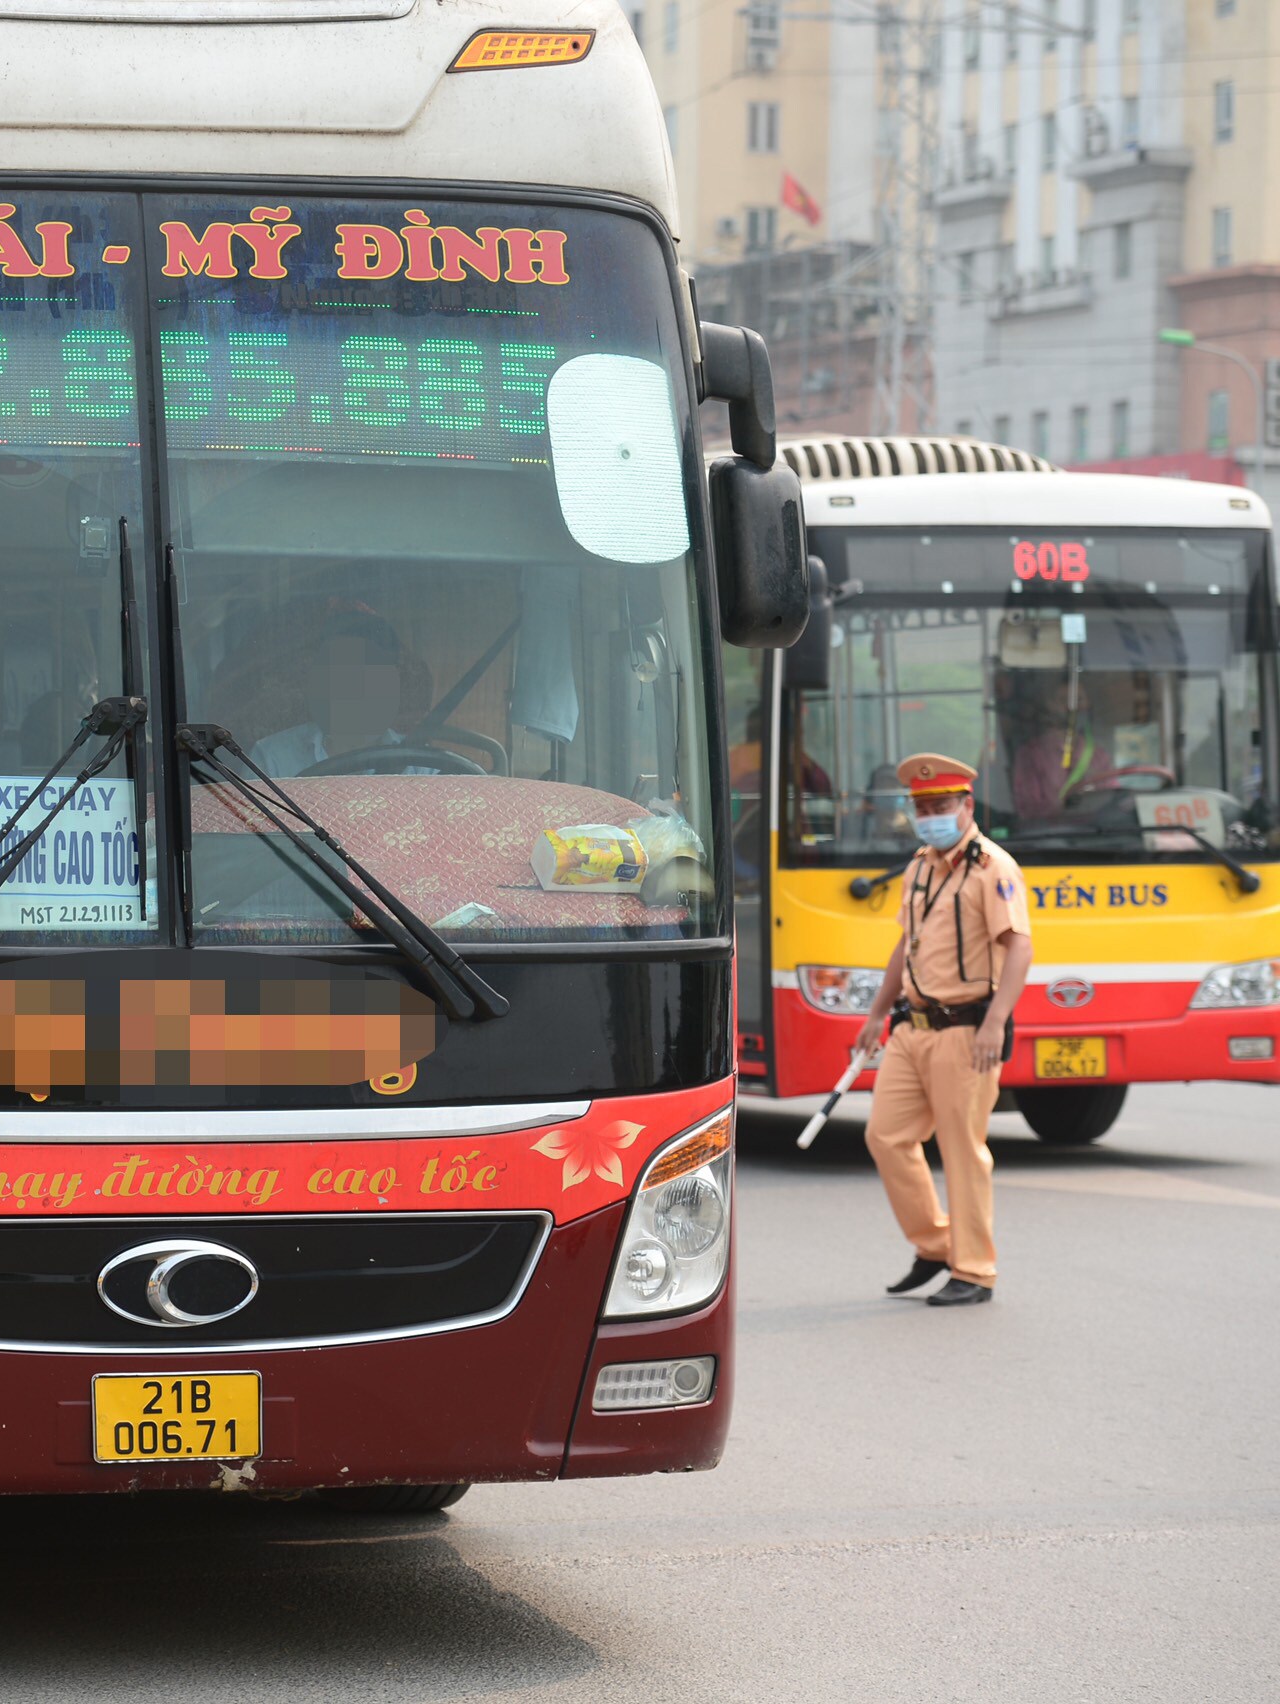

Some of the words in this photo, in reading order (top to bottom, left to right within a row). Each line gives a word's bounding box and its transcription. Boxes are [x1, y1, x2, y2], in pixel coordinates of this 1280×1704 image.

[159, 206, 302, 280] MỸ
[334, 209, 571, 285] ĐÌNH
[1013, 541, 1090, 582] 60B
[53, 829, 95, 886] CAO
[100, 817, 140, 887] TỐC
[1031, 874, 1096, 909] YẾN
[1107, 883, 1168, 907] BUS
[21, 906, 53, 925] MST
[100, 1153, 284, 1206] đường
[307, 1165, 404, 1196] cao
[419, 1149, 501, 1196] tốc
[142, 1379, 212, 1415] 21B
[113, 1418, 237, 1456] 006.71
